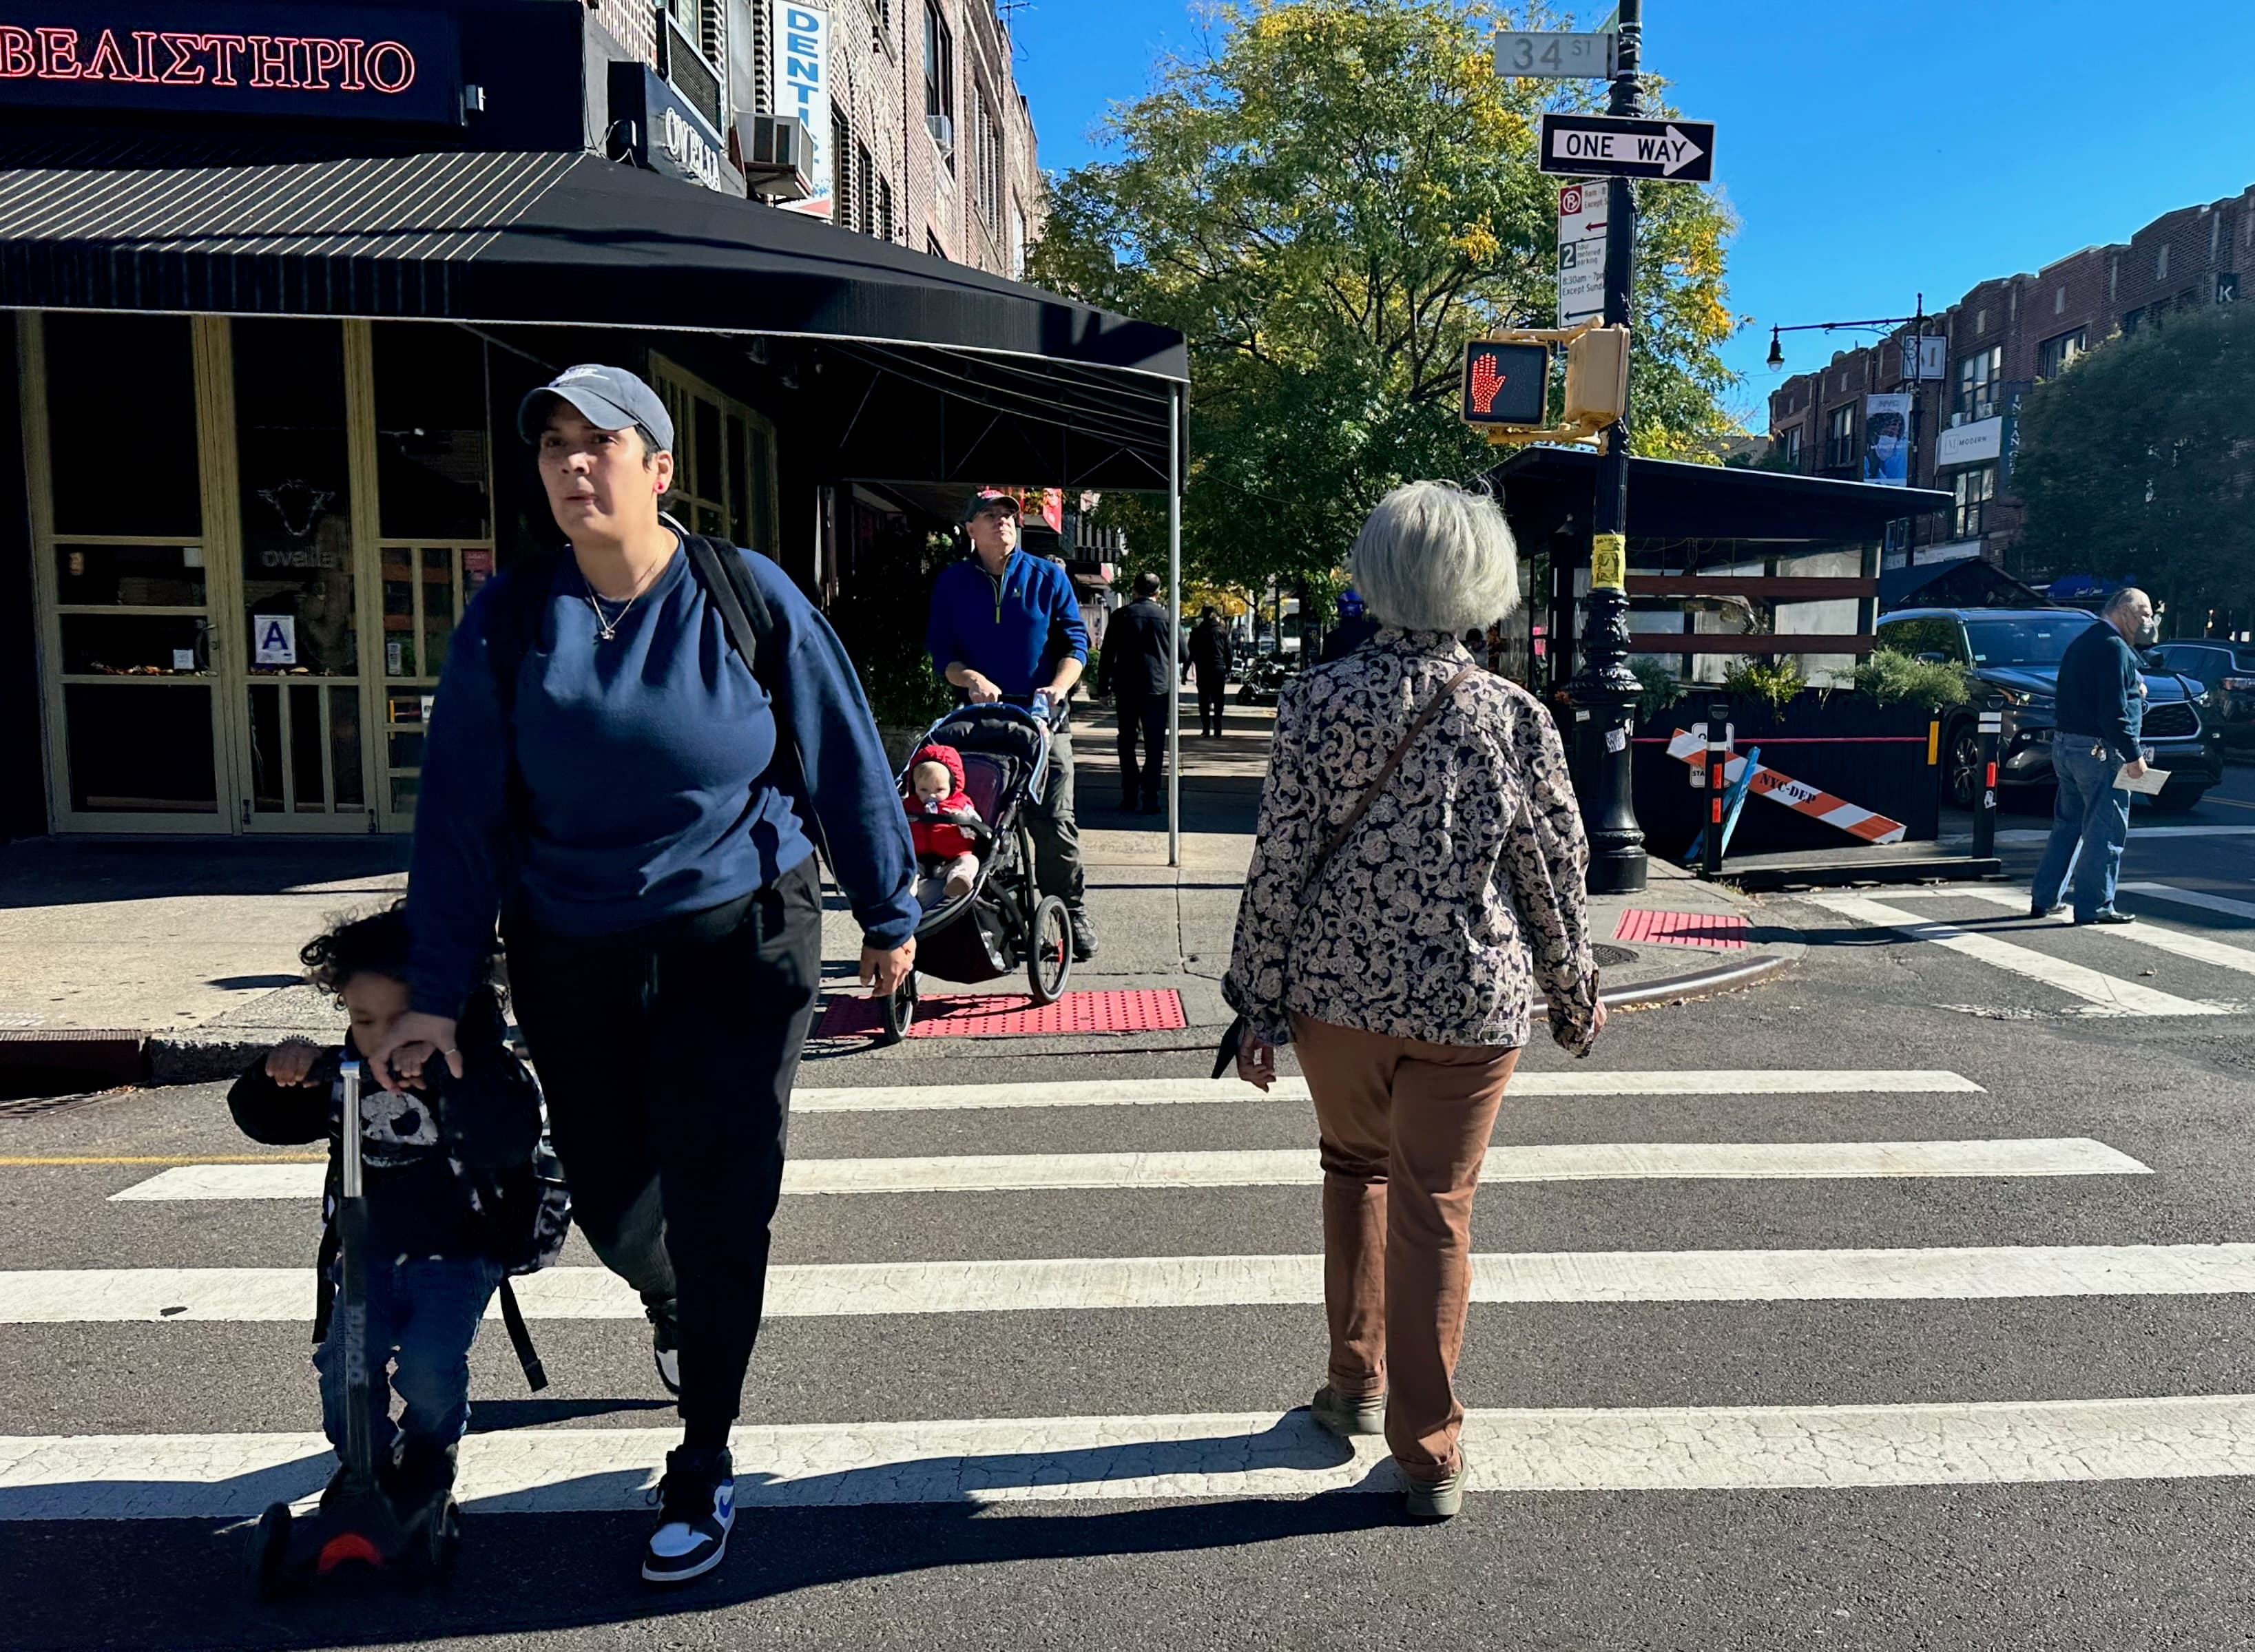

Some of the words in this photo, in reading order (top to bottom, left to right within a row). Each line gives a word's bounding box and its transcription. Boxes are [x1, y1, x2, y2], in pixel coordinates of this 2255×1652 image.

[1514, 38, 1563, 70] 34
[1571, 42, 1592, 57] ST
[787, 8, 819, 164] DENTI
[1566, 134, 1614, 158] ONE
[1638, 138, 1687, 163] WAY
[1563, 244, 1575, 267] 2
[1577, 248, 1601, 258] metered
[1577, 258, 1597, 266] parking
[1563, 275, 1586, 285] 8:30am
[1563, 285, 1584, 295] Except
[1586, 282, 1604, 292] Sund
[1959, 436, 1987, 446] MODERN
[262, 620, 289, 649] A
[1760, 773, 1816, 804] NYC-DEP
